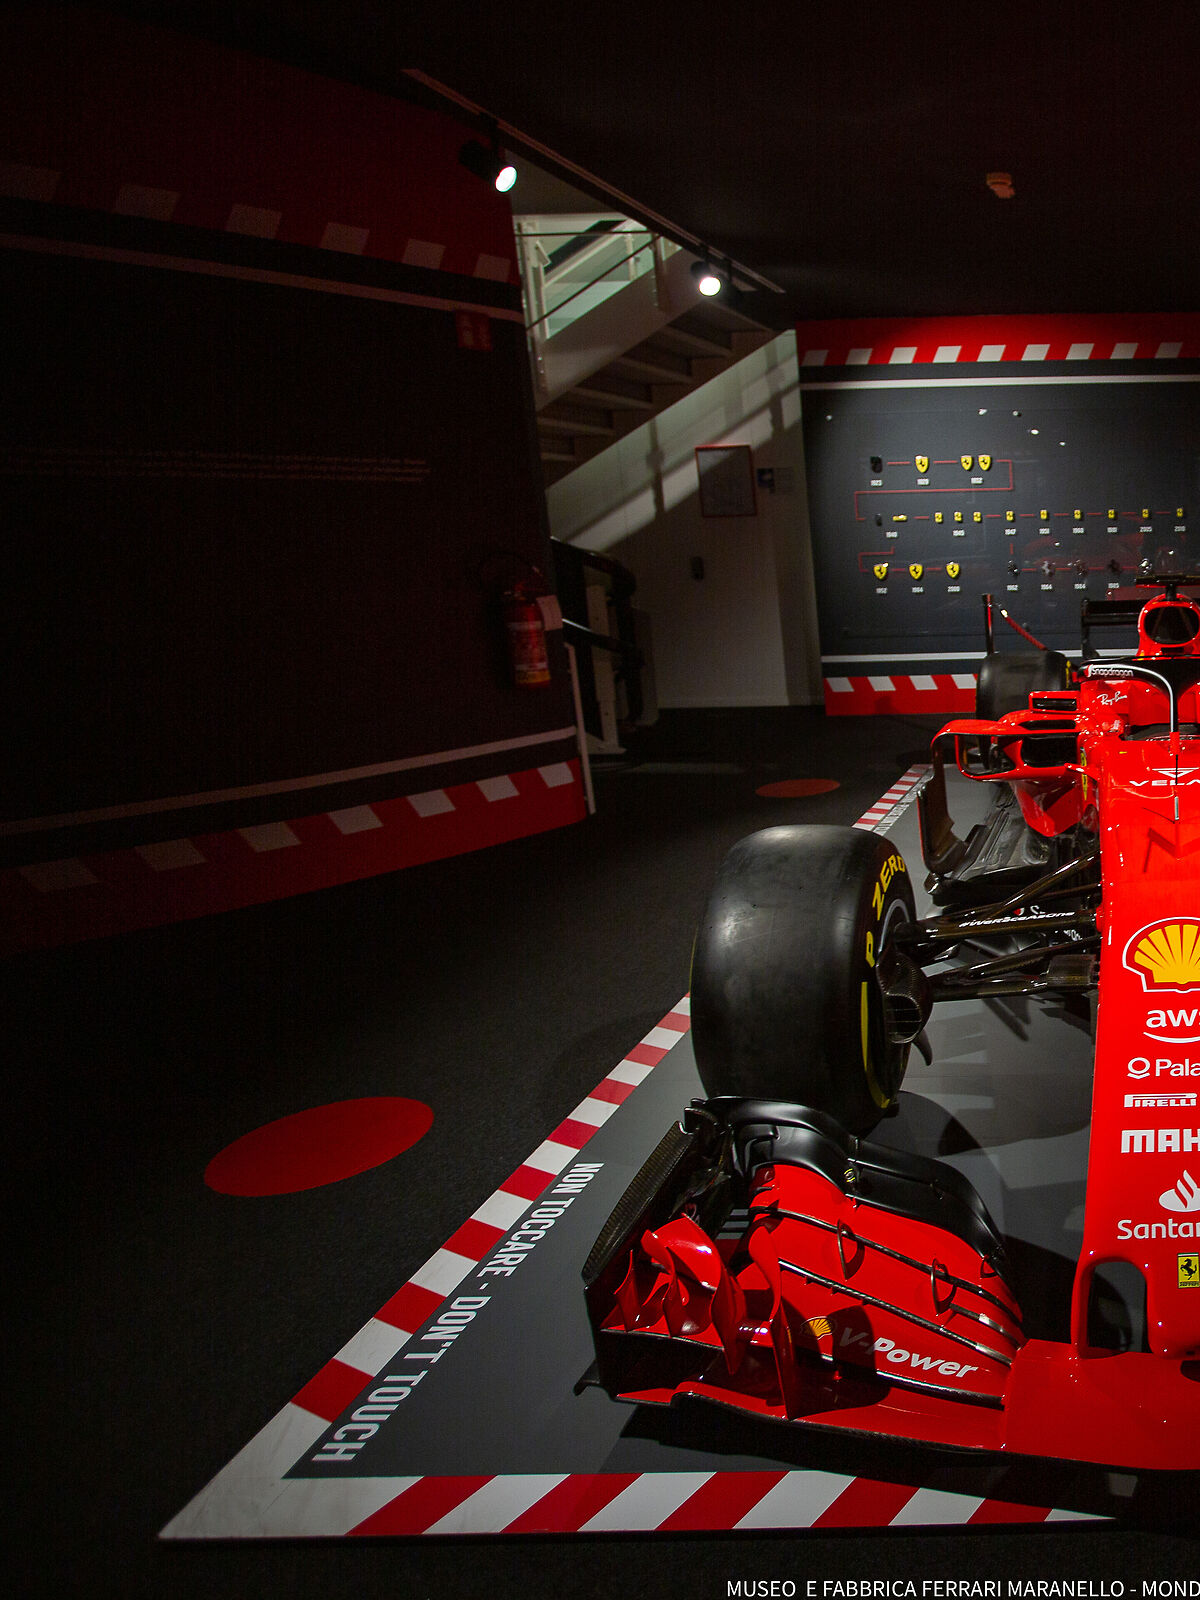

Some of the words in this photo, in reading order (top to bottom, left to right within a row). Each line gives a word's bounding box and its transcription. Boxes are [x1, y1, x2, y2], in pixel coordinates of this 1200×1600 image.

[1092, 666, 1134, 678] Snapdragon
[1097, 690, 1128, 706] Ray-Ban
[872, 855, 906, 921] ZERO
[1123, 1093, 1198, 1108] PIRELLI
[550, 1162, 604, 1194] NON
[476, 1197, 576, 1278] TOCCARE
[403, 1295, 492, 1364] DON'T
[838, 1326, 980, 1379] V-Power
[311, 1370, 429, 1462] TOUCH
